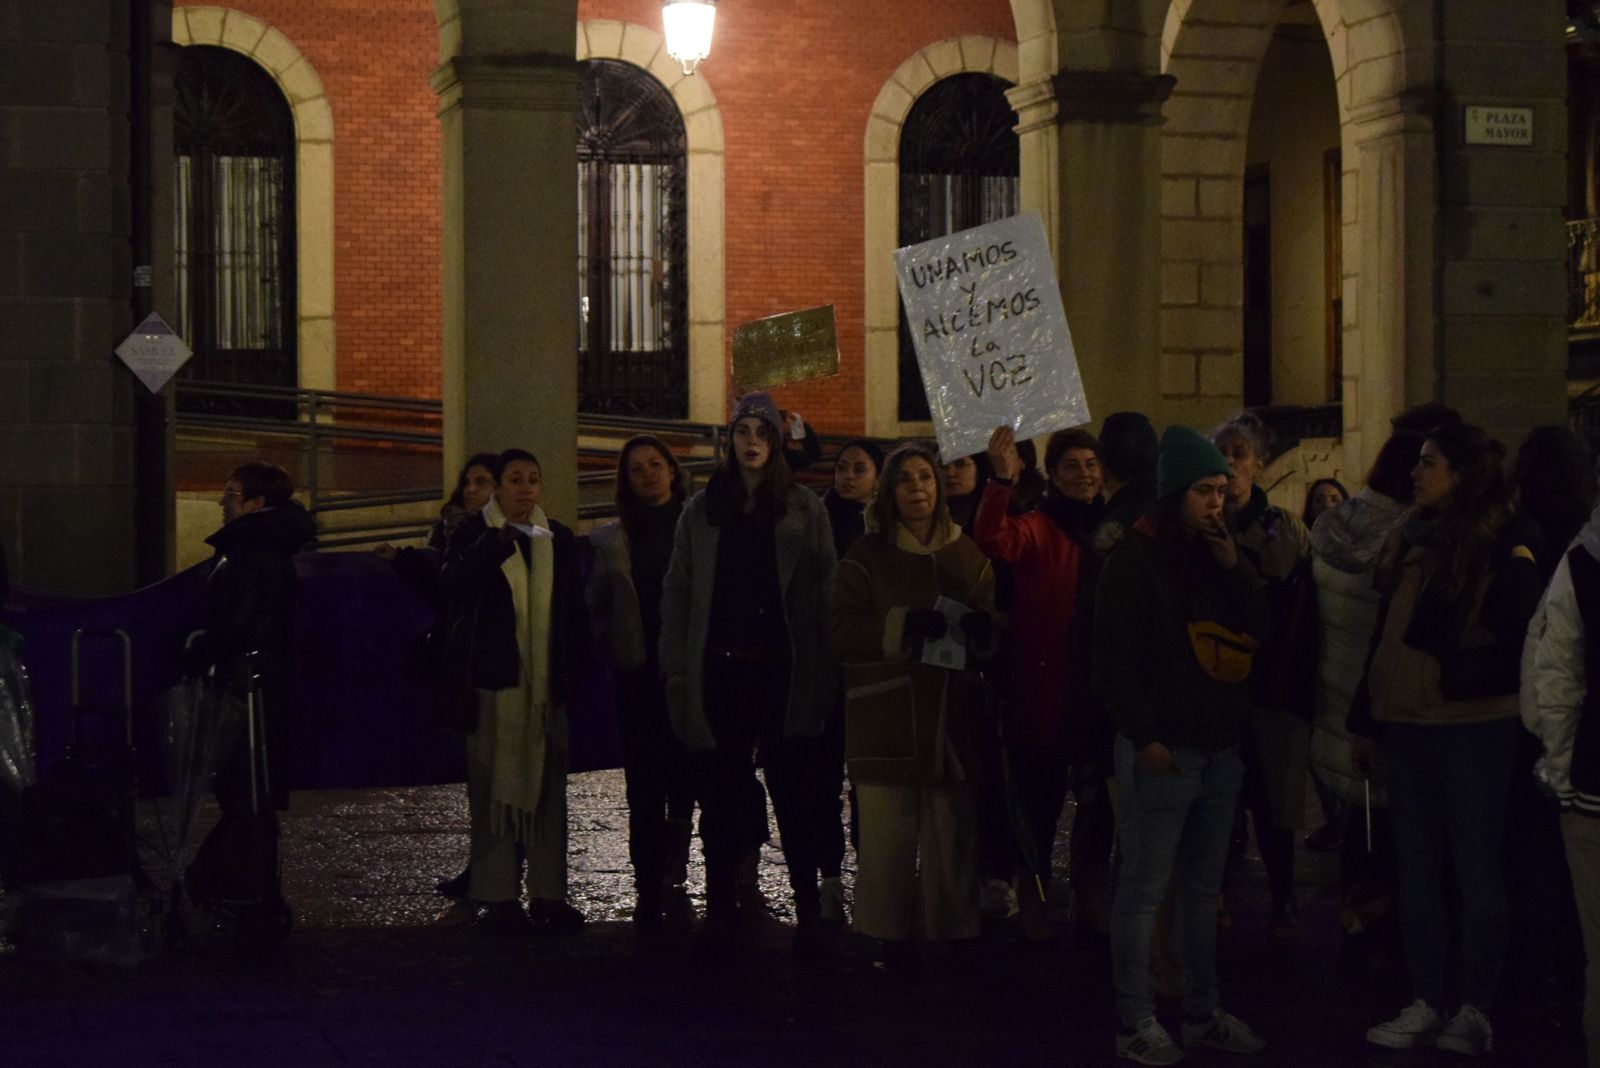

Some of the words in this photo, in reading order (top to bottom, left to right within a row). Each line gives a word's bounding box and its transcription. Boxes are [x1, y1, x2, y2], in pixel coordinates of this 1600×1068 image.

[1486, 112, 1526, 123] PLAZA
[1486, 127, 1528, 138] MAYOR
[911, 241, 1017, 288] UNAMOS
[960, 281, 977, 305] Y
[964, 354, 1032, 397] VOZ
